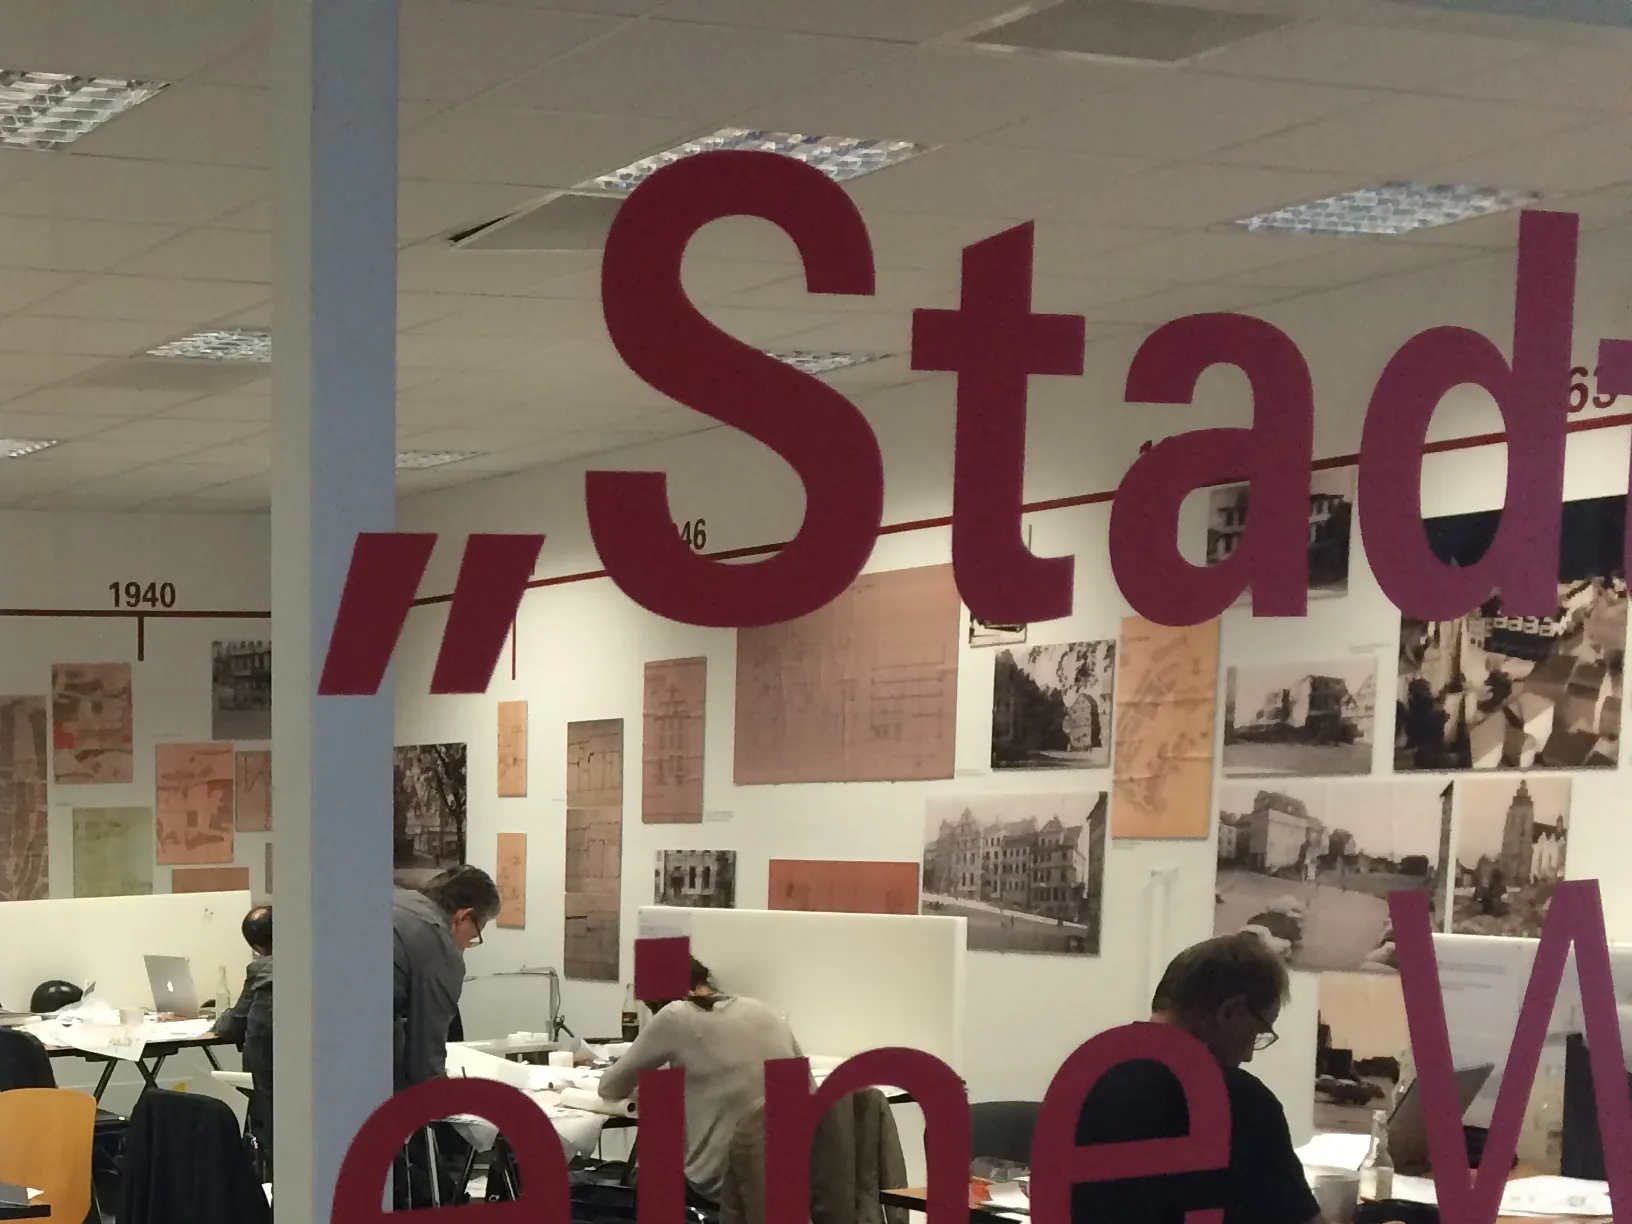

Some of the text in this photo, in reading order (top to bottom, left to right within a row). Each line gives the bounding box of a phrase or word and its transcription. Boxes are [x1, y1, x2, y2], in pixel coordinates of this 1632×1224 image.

[319, 150, 1632, 696] „Stad
[679, 518, 707, 550] 46
[108, 581, 176, 608] 1940
